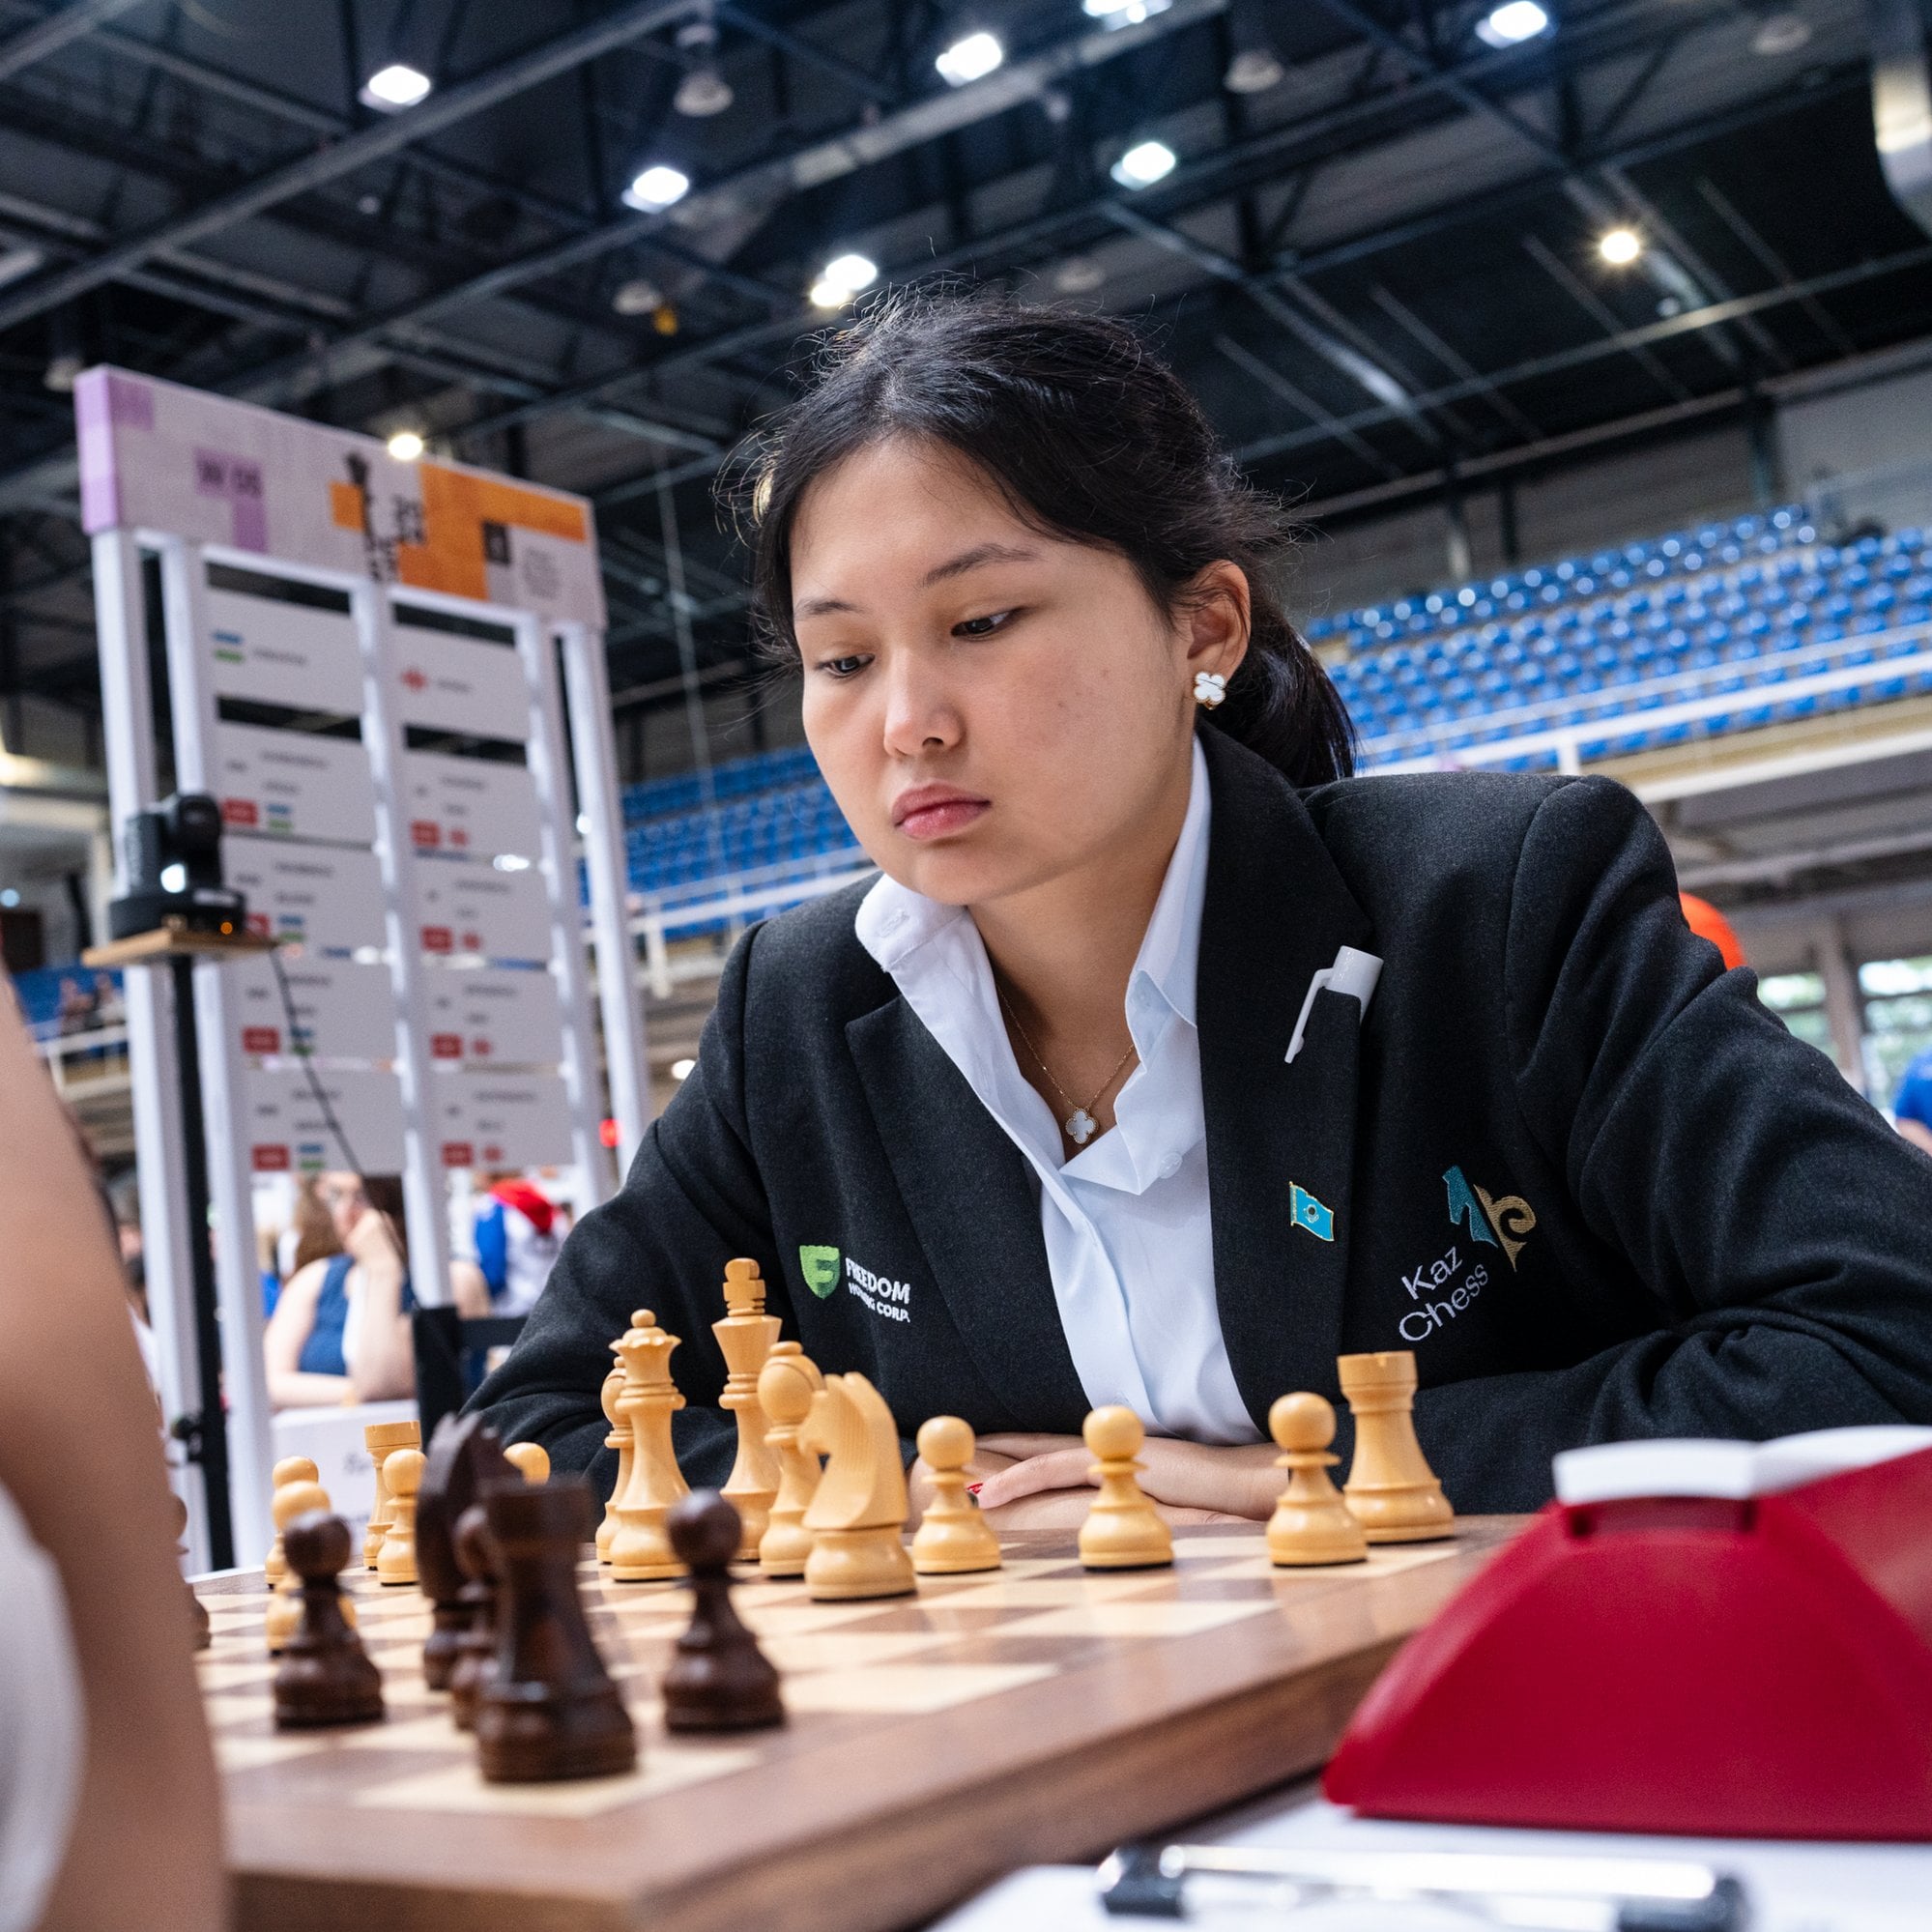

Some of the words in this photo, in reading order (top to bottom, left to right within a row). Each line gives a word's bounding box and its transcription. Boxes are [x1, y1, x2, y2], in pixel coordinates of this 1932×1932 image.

[845, 1256, 911, 1305] FREEDOM
[1401, 1246, 1463, 1300] Kaz
[1399, 1263, 1488, 1341] Chess
